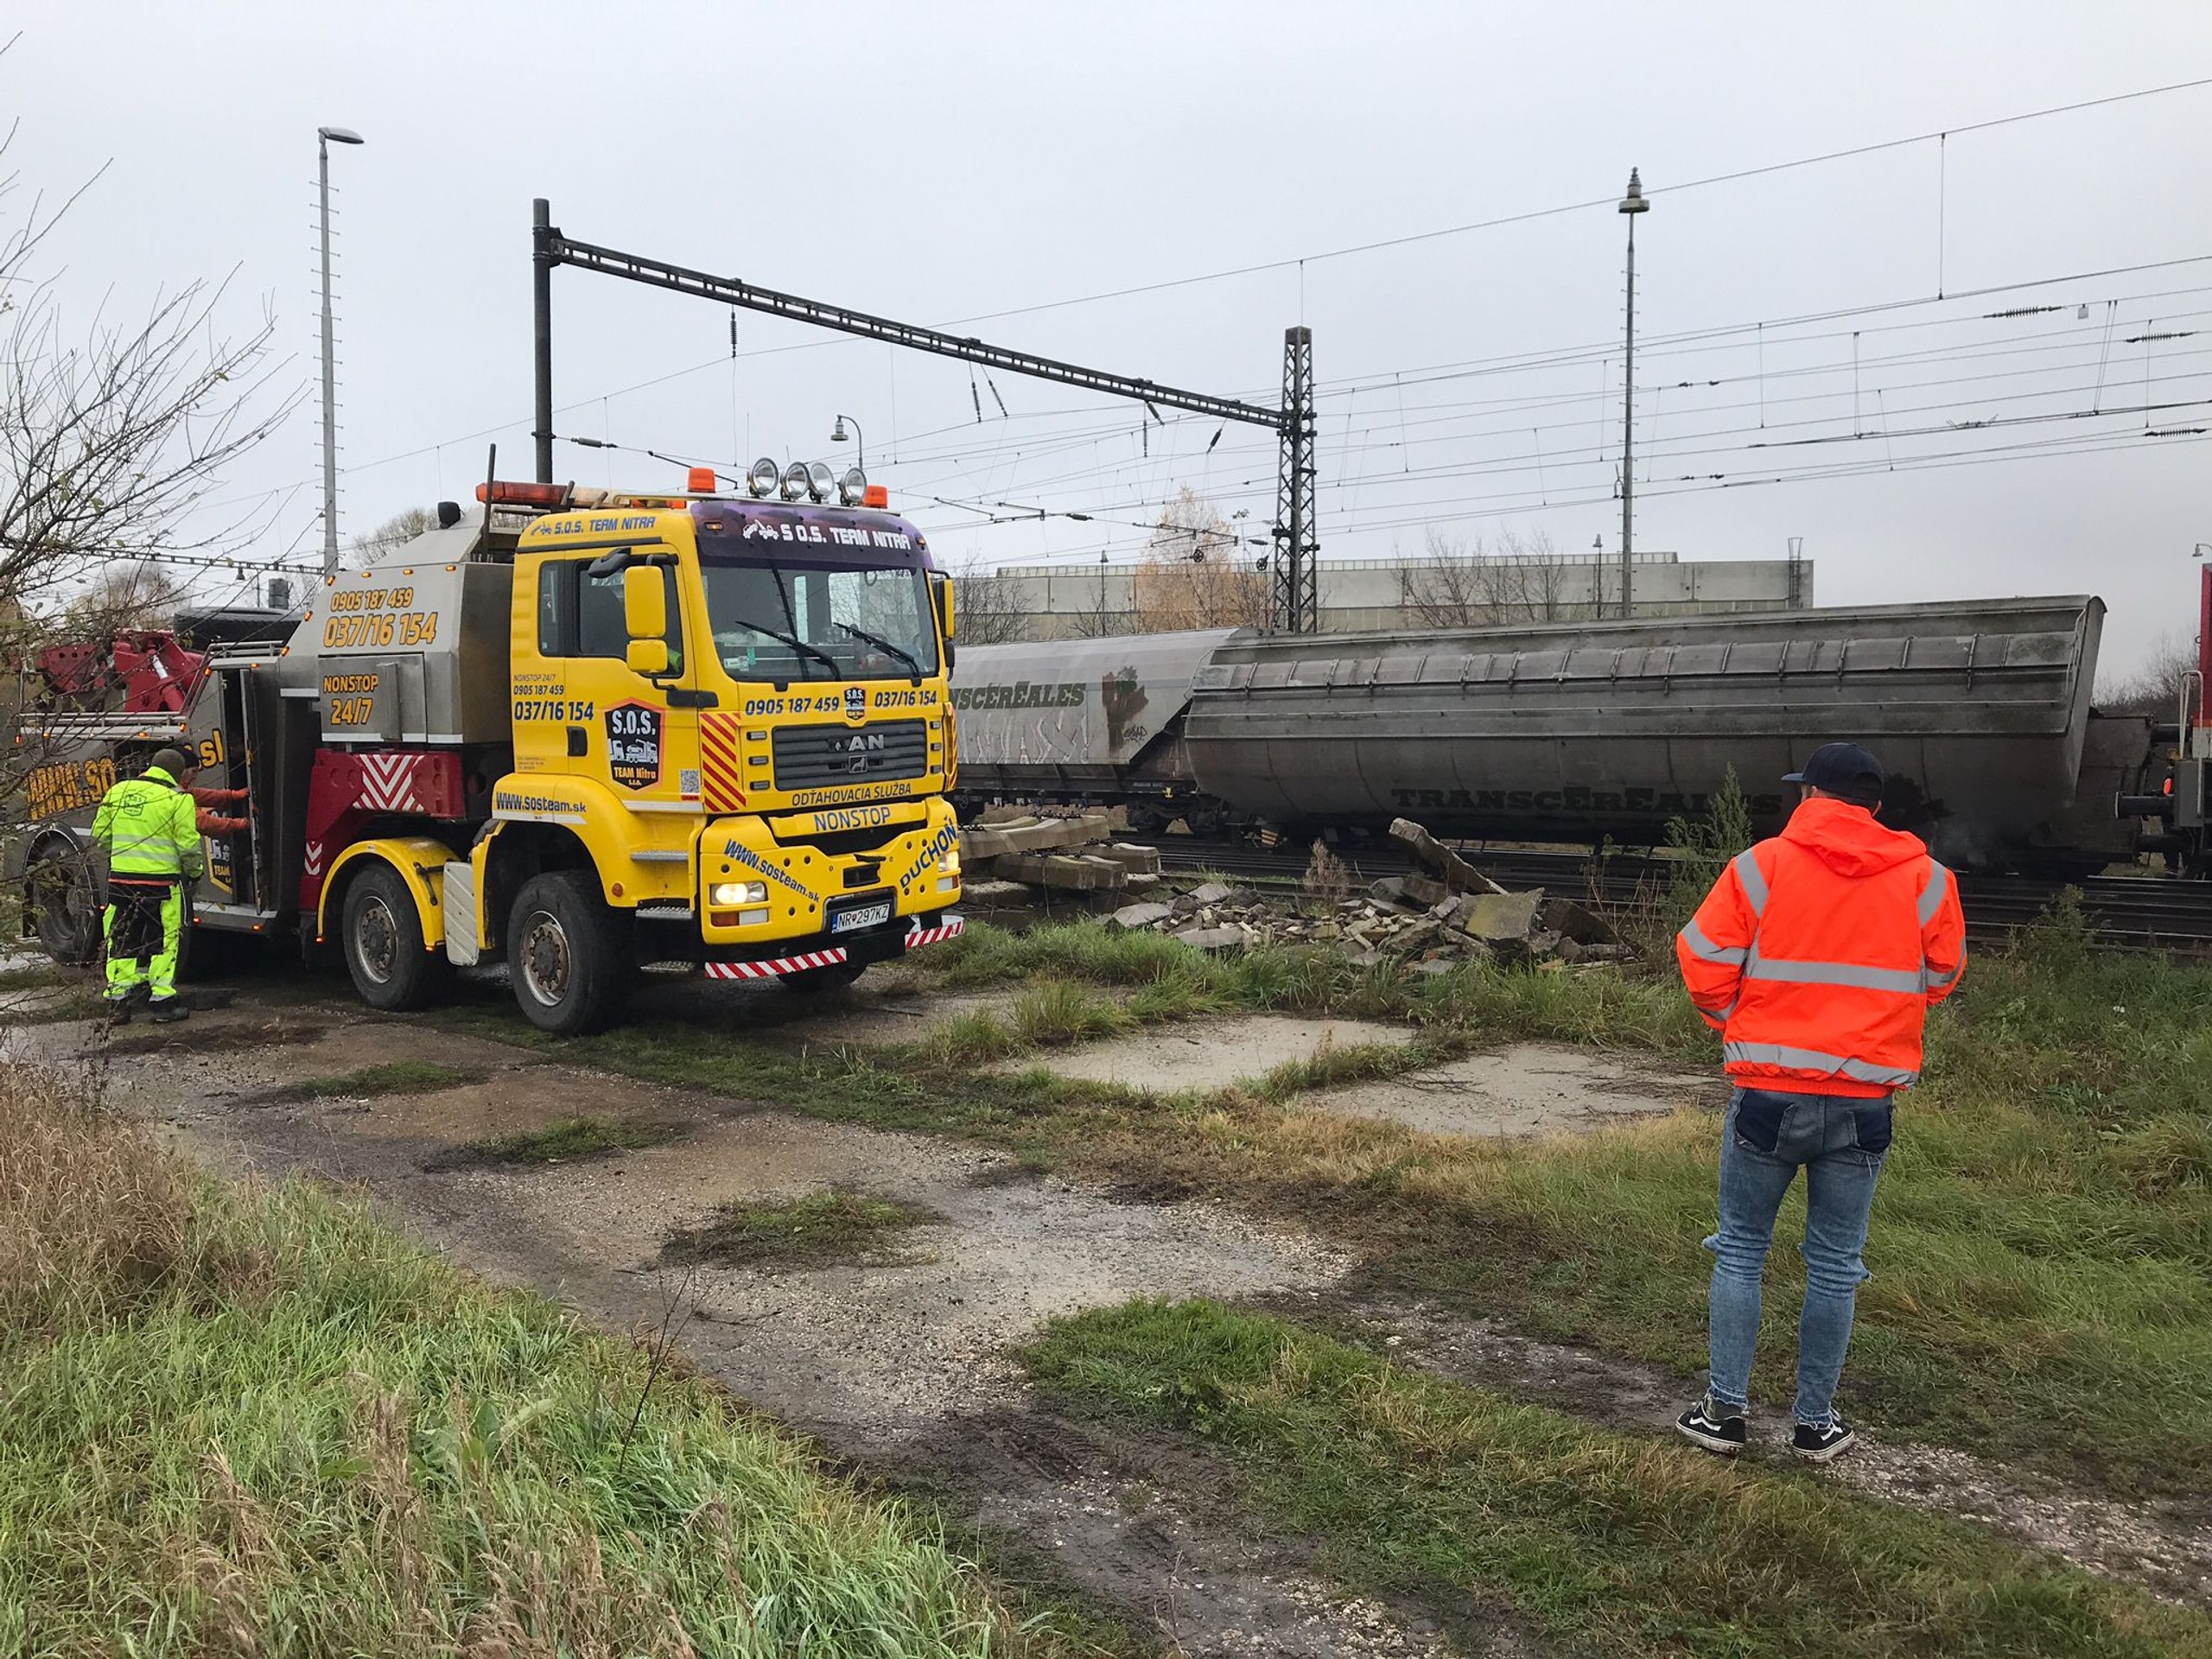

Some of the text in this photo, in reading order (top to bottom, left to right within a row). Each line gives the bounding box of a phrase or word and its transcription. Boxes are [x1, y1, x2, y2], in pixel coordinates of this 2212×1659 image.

[554, 517, 656, 534] S.O.S. TEAM NITRA
[830, 527, 870, 546] TEAM
[872, 531, 912, 550] NITRA
[331, 587, 414, 612] 0905 187 459
[322, 612, 438, 647] 037/16 154
[322, 674, 378, 693] NONSTOP
[513, 685, 564, 695] 0905 187 459
[745, 696, 840, 715] 0905 187 459
[874, 690, 938, 708] 037/16 154
[330, 697, 374, 725] 24/7
[514, 701, 594, 721] 037/16 154
[612, 710, 656, 735] S.O.S.
[613, 766, 635, 778] TEAM
[791, 782, 912, 806] ODŤAHOVACIA SLUŽBA
[814, 806, 891, 831] NONSTOP
